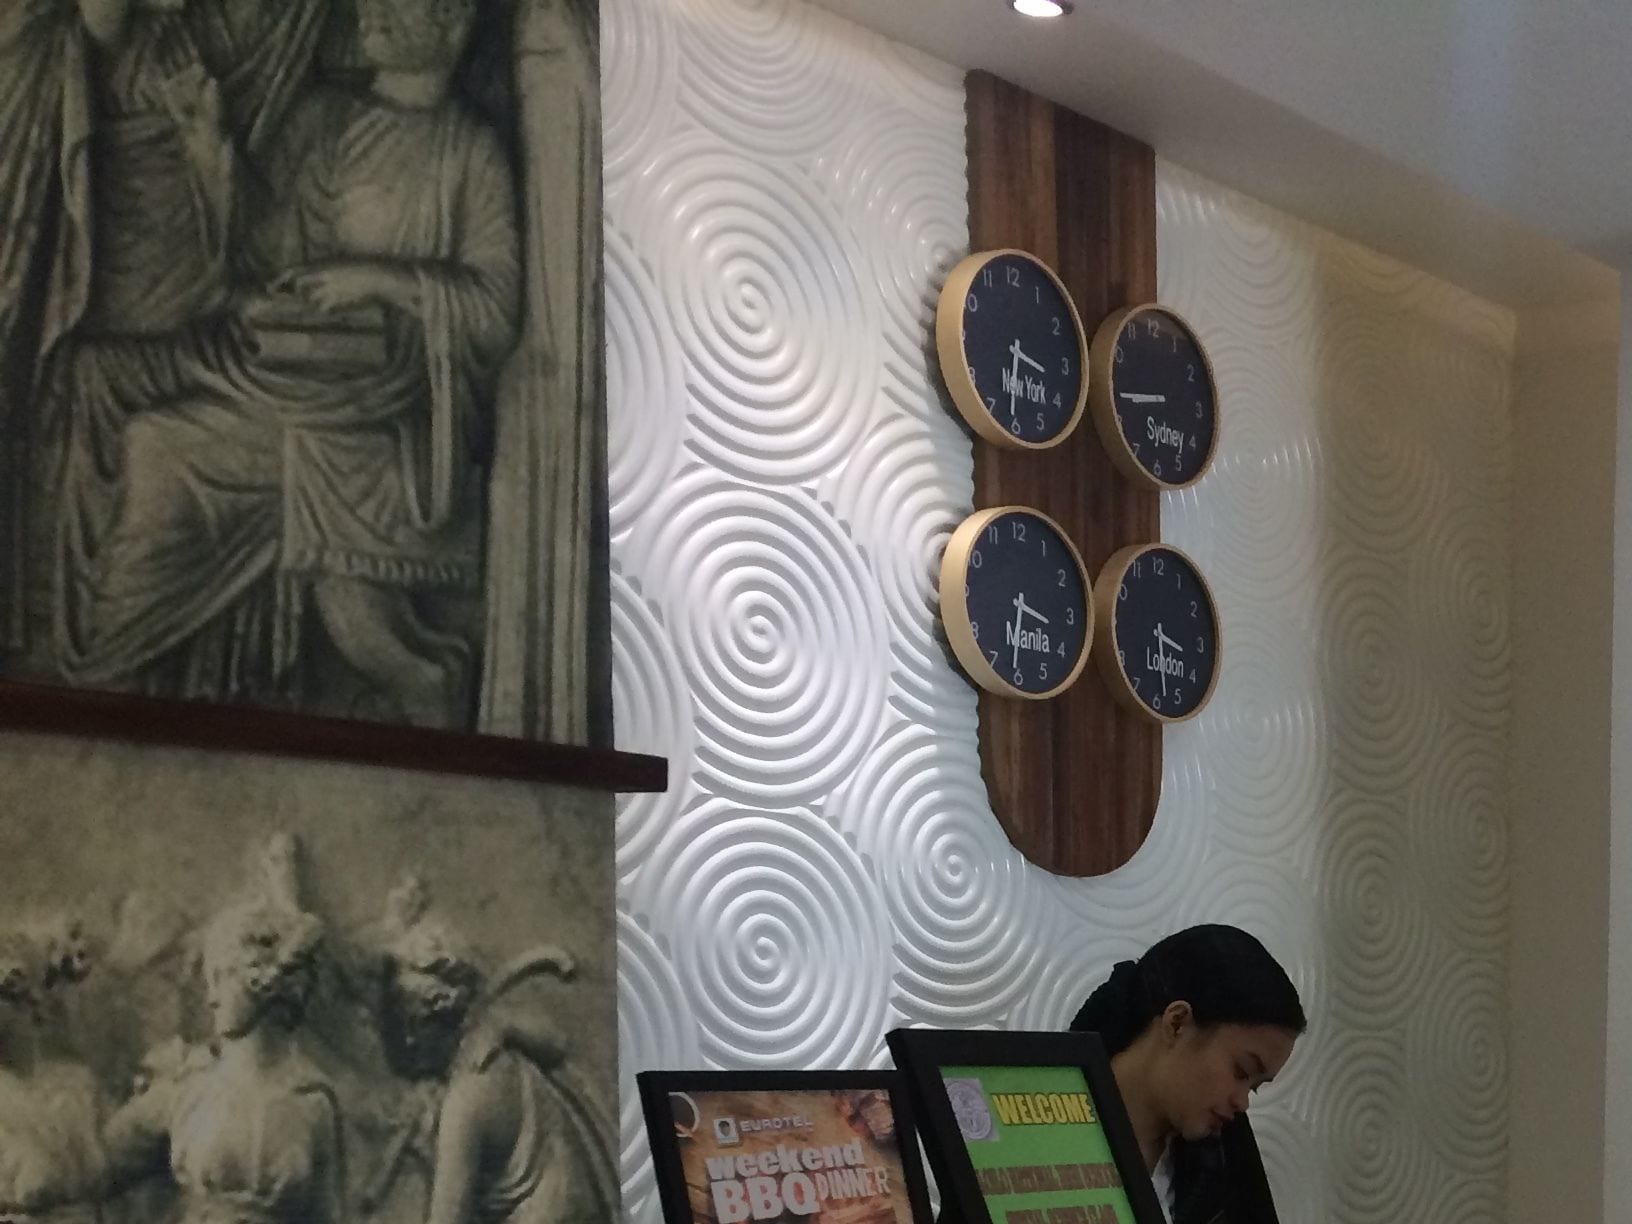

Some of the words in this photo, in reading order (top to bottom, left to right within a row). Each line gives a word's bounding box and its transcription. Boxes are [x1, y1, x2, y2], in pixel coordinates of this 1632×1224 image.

[983, 269, 992, 287] 11
[1006, 266, 1020, 287] 12
[1035, 287, 1040, 304] 1
[1052, 317, 1061, 335] 2
[1148, 319, 1160, 339] 12
[1062, 357, 1069, 376] 3
[1187, 364, 1195, 382] 2
[1025, 375, 1046, 404] York
[1053, 392, 1062, 408] 4
[1195, 401, 1203, 418] 3
[1011, 417, 1021, 435] 6
[1036, 412, 1045, 431] 5
[1147, 416, 1184, 454] Sydney
[1189, 435, 1196, 449] 4
[1153, 460, 1162, 478] 6
[1175, 454, 1182, 472] 5
[989, 526, 998, 545] 11
[1012, 522, 1026, 542] 12
[1041, 540, 1046, 557] 1
[1132, 559, 1142, 578] 11
[1152, 557, 1165, 576] 12
[1057, 569, 1067, 588] 2
[1177, 573, 1182, 590] 1
[1066, 607, 1075, 626] 3
[1190, 601, 1199, 618] 2
[1006, 621, 1050, 653] Manila
[1196, 636, 1205, 653] 3
[1057, 642, 1066, 658] 4
[989, 650, 999, 669] 7
[1013, 668, 1024, 686] 6
[1039, 663, 1048, 680] 5
[1189, 668, 1196, 684] 4
[1152, 692, 1162, 709] 6
[1174, 688, 1182, 705] 5
[990, 1093, 1096, 1125] WELCOME
[739, 1115, 814, 1132] EUROTEL
[705, 1138, 865, 1180] weekend
[711, 1172, 821, 1224] BBQ
[815, 1166, 891, 1201] DINNER
